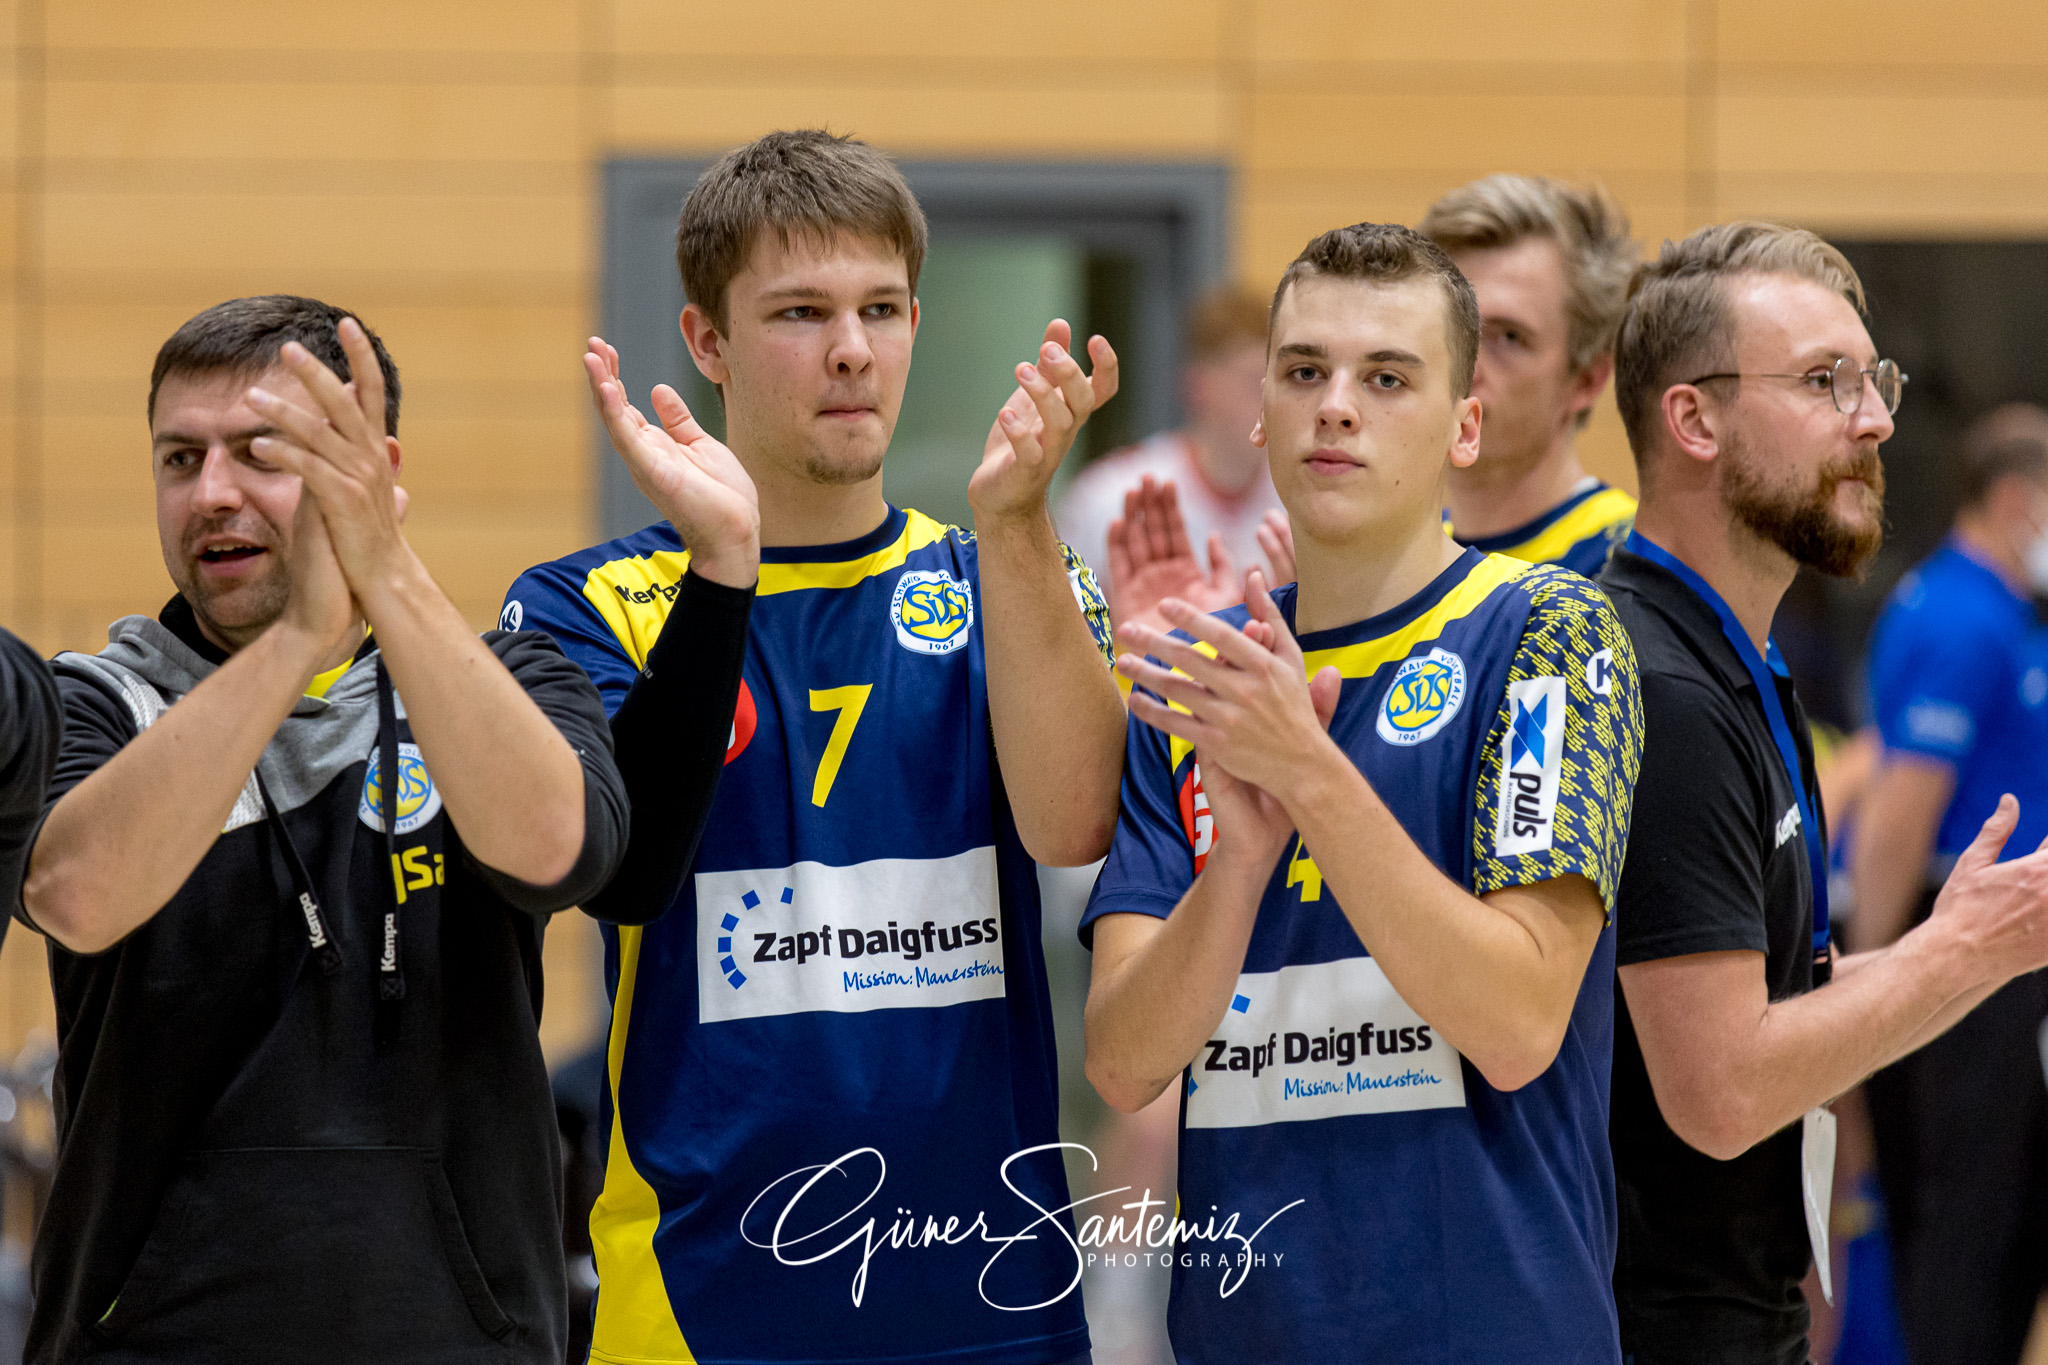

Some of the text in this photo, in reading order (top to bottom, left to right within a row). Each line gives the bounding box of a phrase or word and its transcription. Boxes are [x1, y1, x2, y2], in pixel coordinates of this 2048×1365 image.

[929, 639, 954, 651] 1967
[809, 683, 874, 808] 7
[1398, 731, 1422, 742] 1967
[1509, 771, 1548, 839] puls
[299, 891, 327, 949] Kempa
[381, 912, 398, 972] Kempa
[753, 917, 999, 965] Zapf Daigfuss
[1204, 1022, 1432, 1078] Zapf Daigfuss
